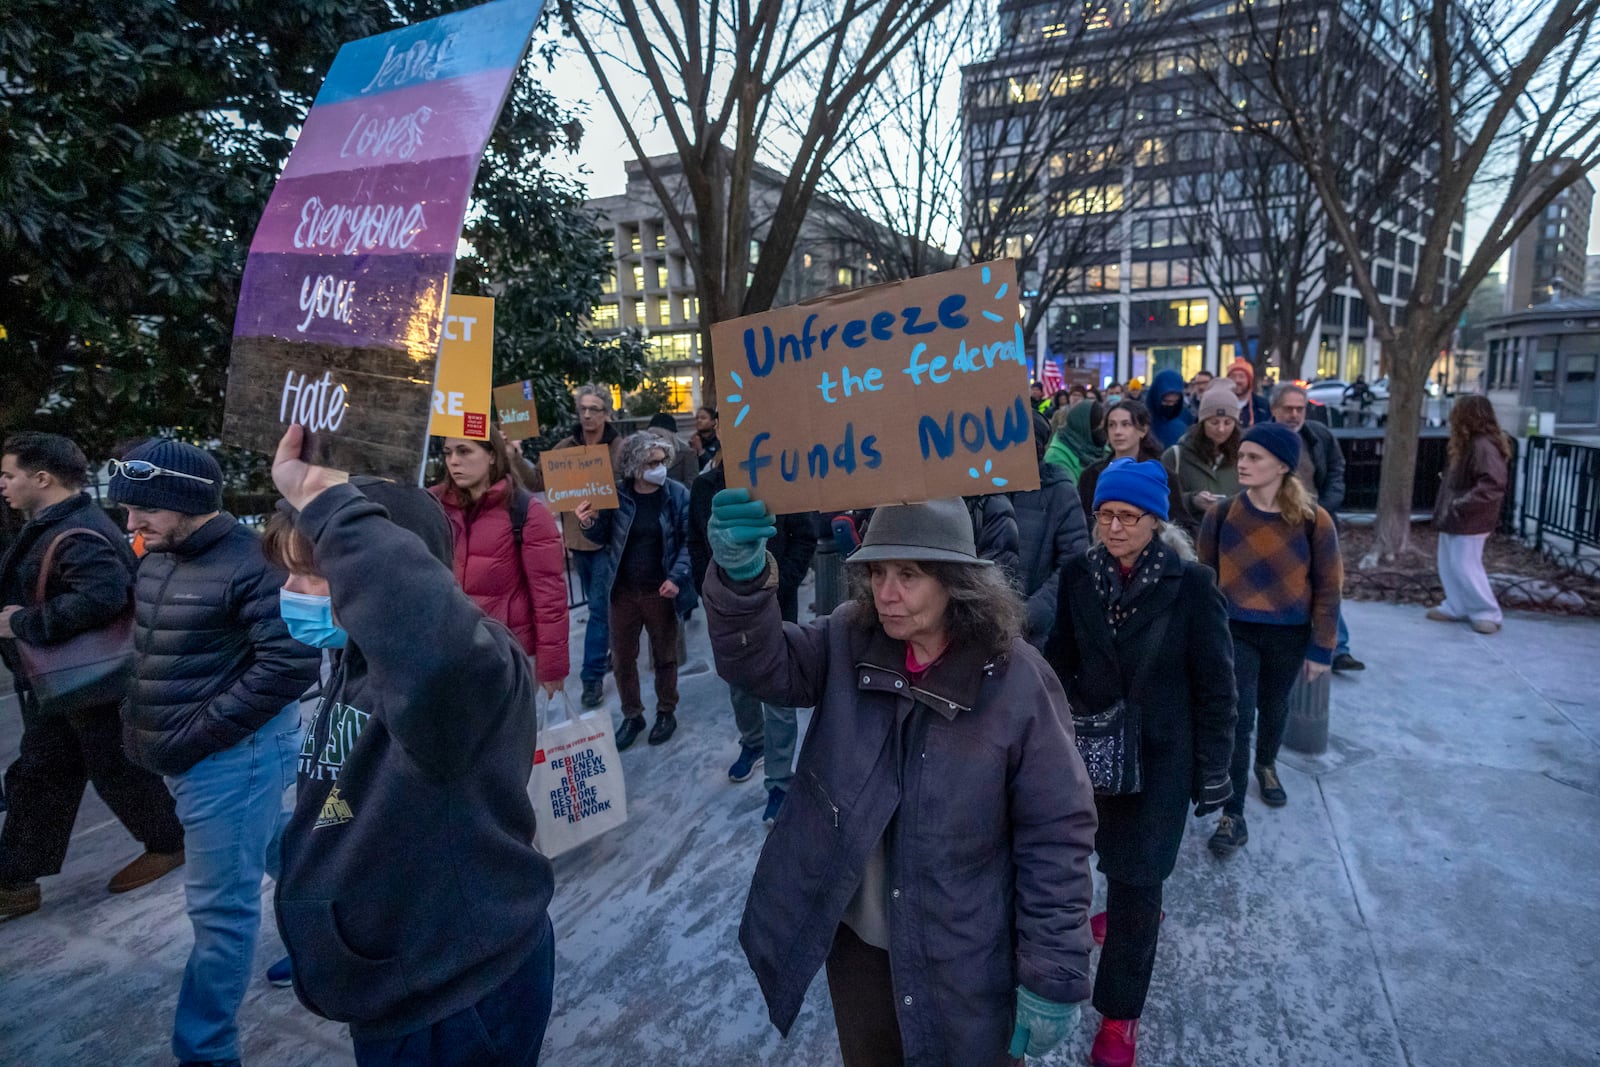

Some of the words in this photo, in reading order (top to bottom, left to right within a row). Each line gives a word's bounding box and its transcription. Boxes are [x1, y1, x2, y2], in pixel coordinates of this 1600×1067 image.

[361, 33, 457, 93] Jesus
[340, 105, 432, 159] Loves
[293, 195, 427, 255] Everyone
[296, 273, 355, 332] you
[743, 293, 970, 378] Unfreeze
[817, 366, 885, 404] the
[903, 322, 1027, 386] federal
[279, 369, 347, 433] Hate
[738, 421, 883, 488] funds
[917, 395, 1031, 462] NOW
[577, 456, 603, 470] harm
[547, 482, 614, 504] Communities
[551, 748, 594, 770] REBUILD
[566, 755, 603, 776] RENEW
[561, 764, 607, 787] REDRESS
[550, 780, 587, 801] REPAIR
[552, 785, 598, 810] RESTORE
[553, 796, 598, 819] RETHINK
[568, 800, 612, 824] REWORK
